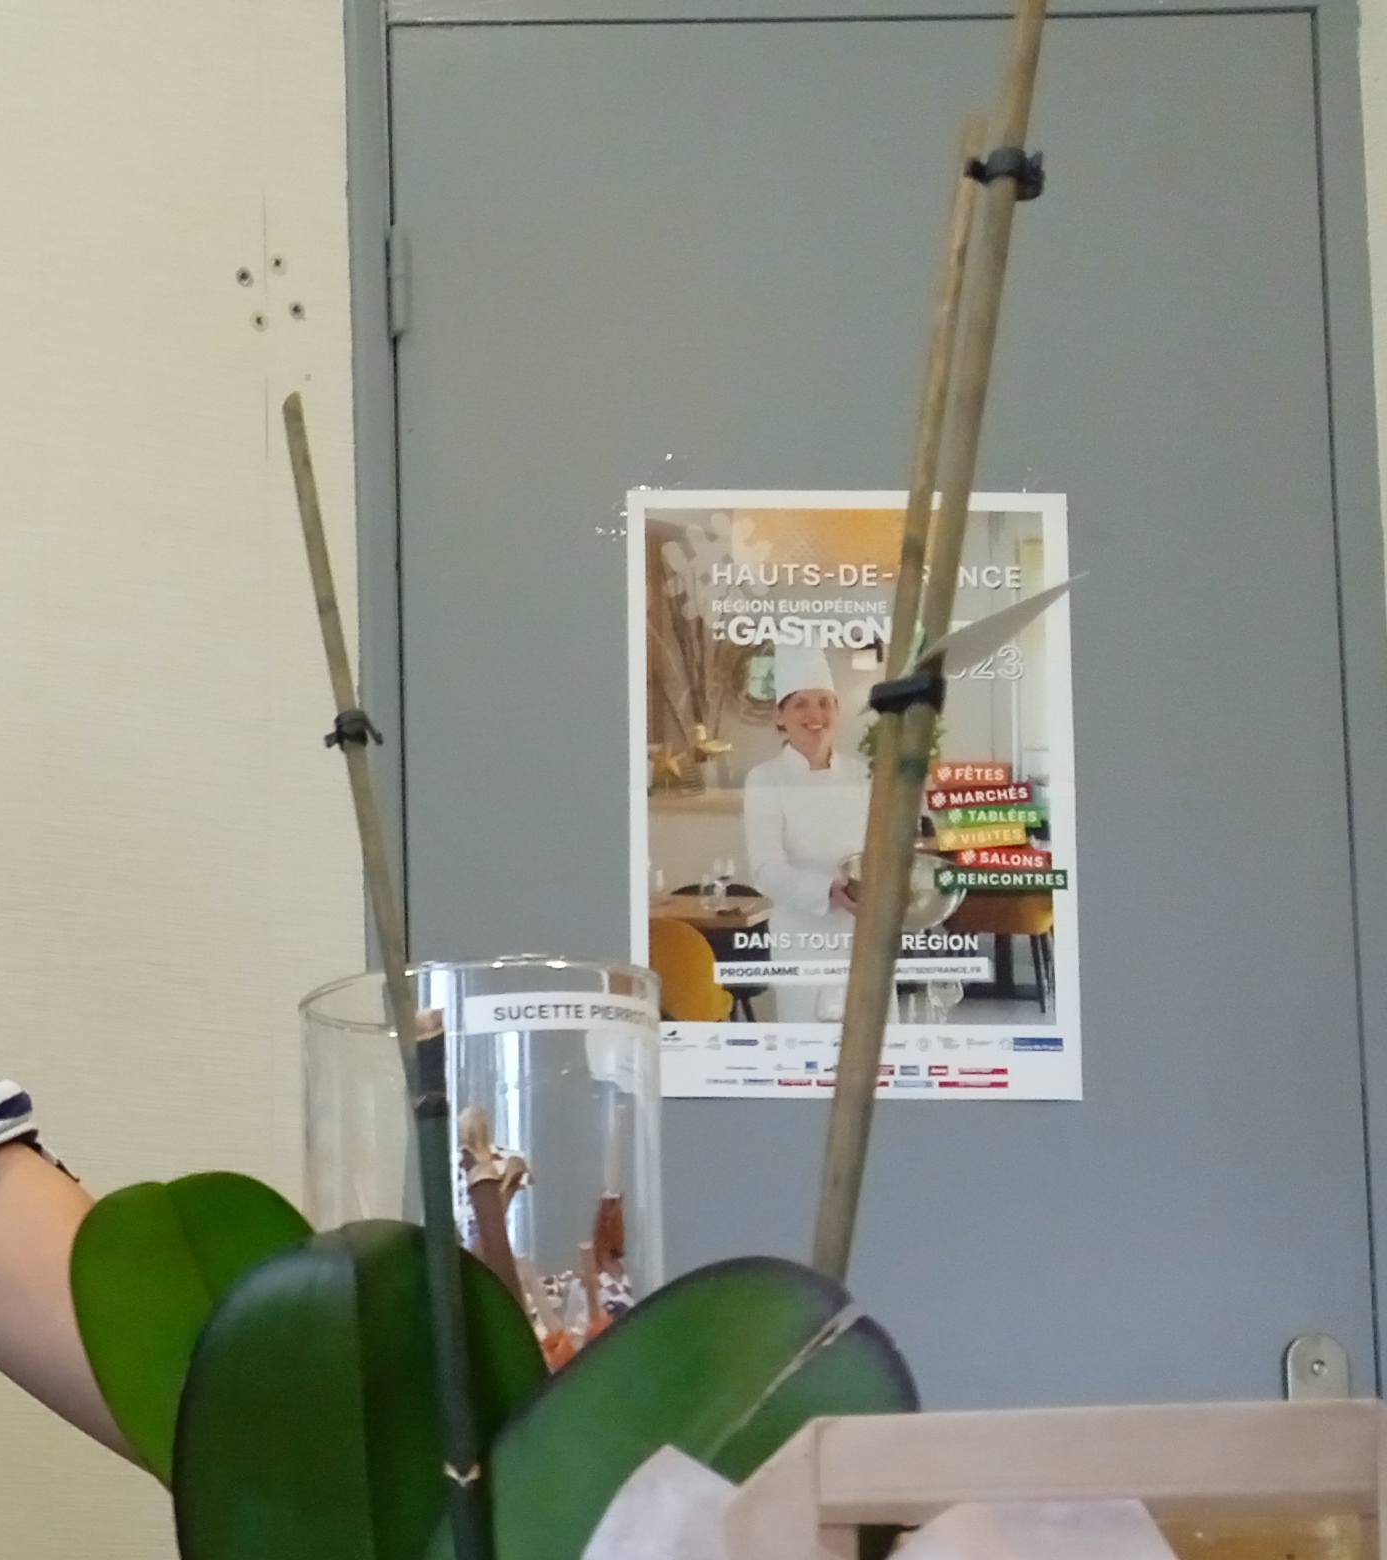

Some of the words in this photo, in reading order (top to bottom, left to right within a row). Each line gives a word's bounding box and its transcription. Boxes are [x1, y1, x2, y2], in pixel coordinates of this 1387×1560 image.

[712, 598, 776, 614] RÉGION
[778, 597, 888, 616] EUROPÉENNE
[954, 764, 1005, 782] FÊTES
[948, 785, 1029, 805] MARCHÉS
[967, 808, 1038, 823] TABLÉES
[960, 828, 1023, 845] VISITES
[979, 851, 1044, 868] SALONS
[956, 873, 1065, 886] RENCONTRES
[733, 932, 793, 951] DANS
[797, 932, 854, 951] TOUT
[900, 929, 979, 952] RÉGION
[719, 967, 800, 978] PROGRAMME
[492, 1004, 584, 1021] SUCETTE
